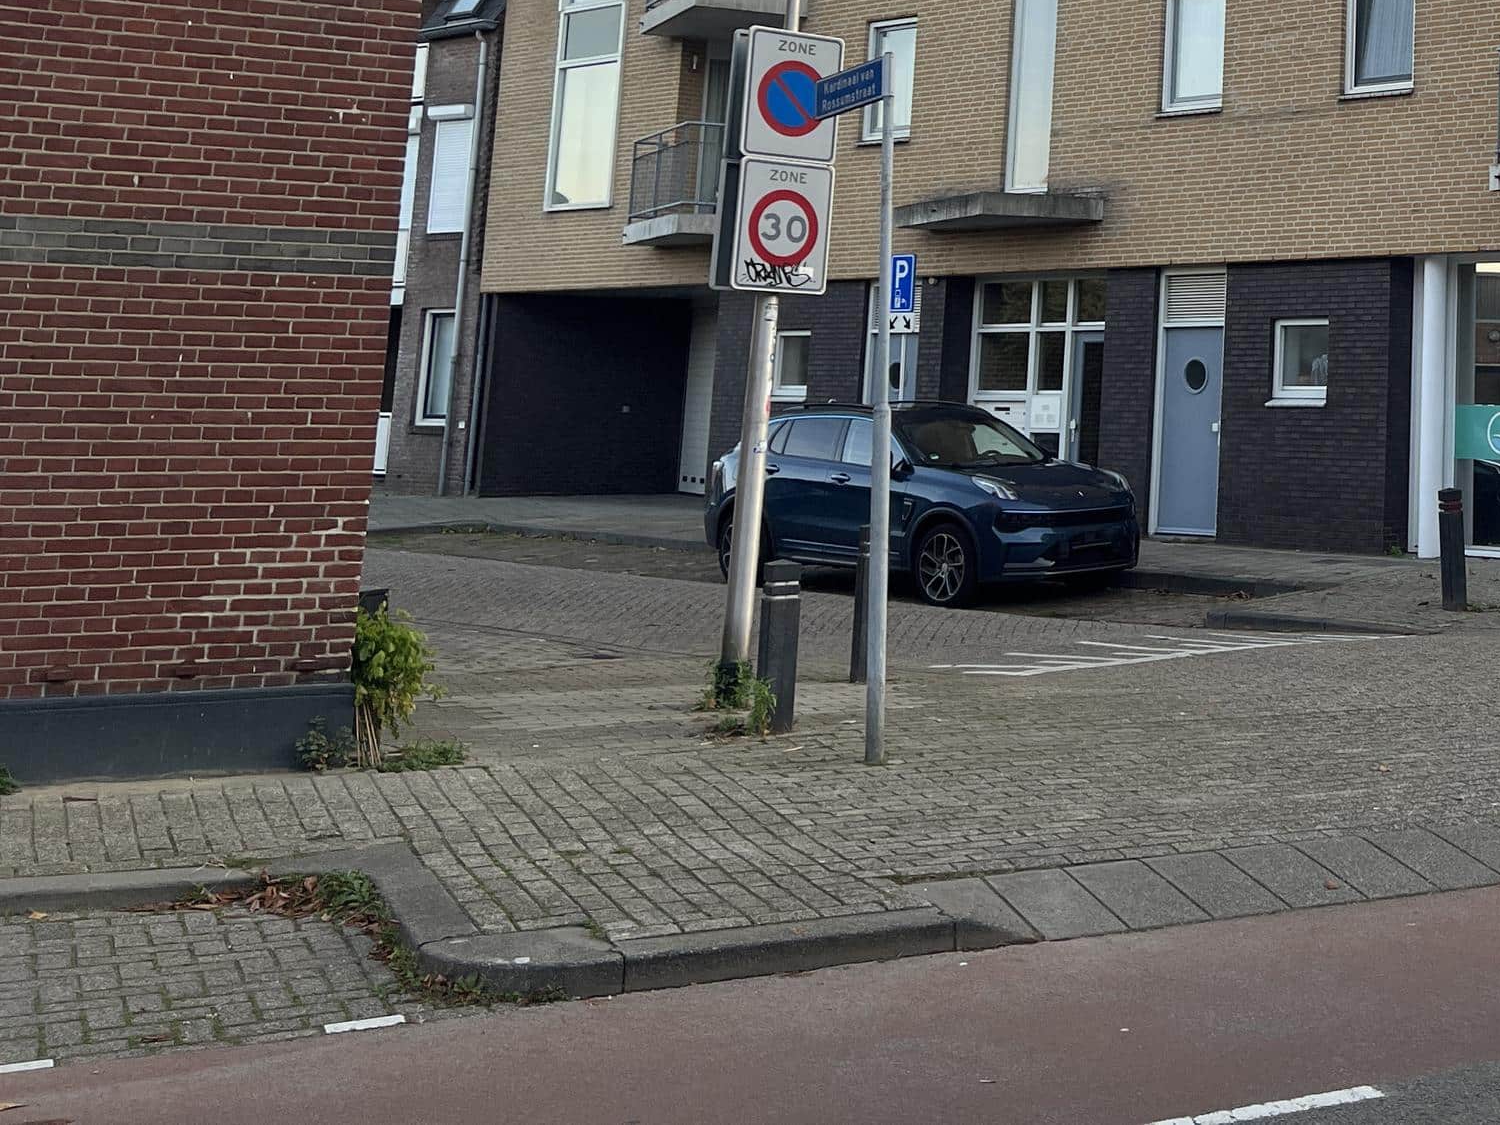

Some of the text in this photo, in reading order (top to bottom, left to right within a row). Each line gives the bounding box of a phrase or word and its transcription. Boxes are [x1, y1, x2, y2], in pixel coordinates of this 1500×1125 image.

[778, 39, 817, 56] ZONE
[860, 69, 875, 82] van
[822, 82, 876, 112] Rossumstraat
[769, 169, 808, 184] ZONE
[760, 213, 807, 243] 30
[895, 259, 909, 289] P
